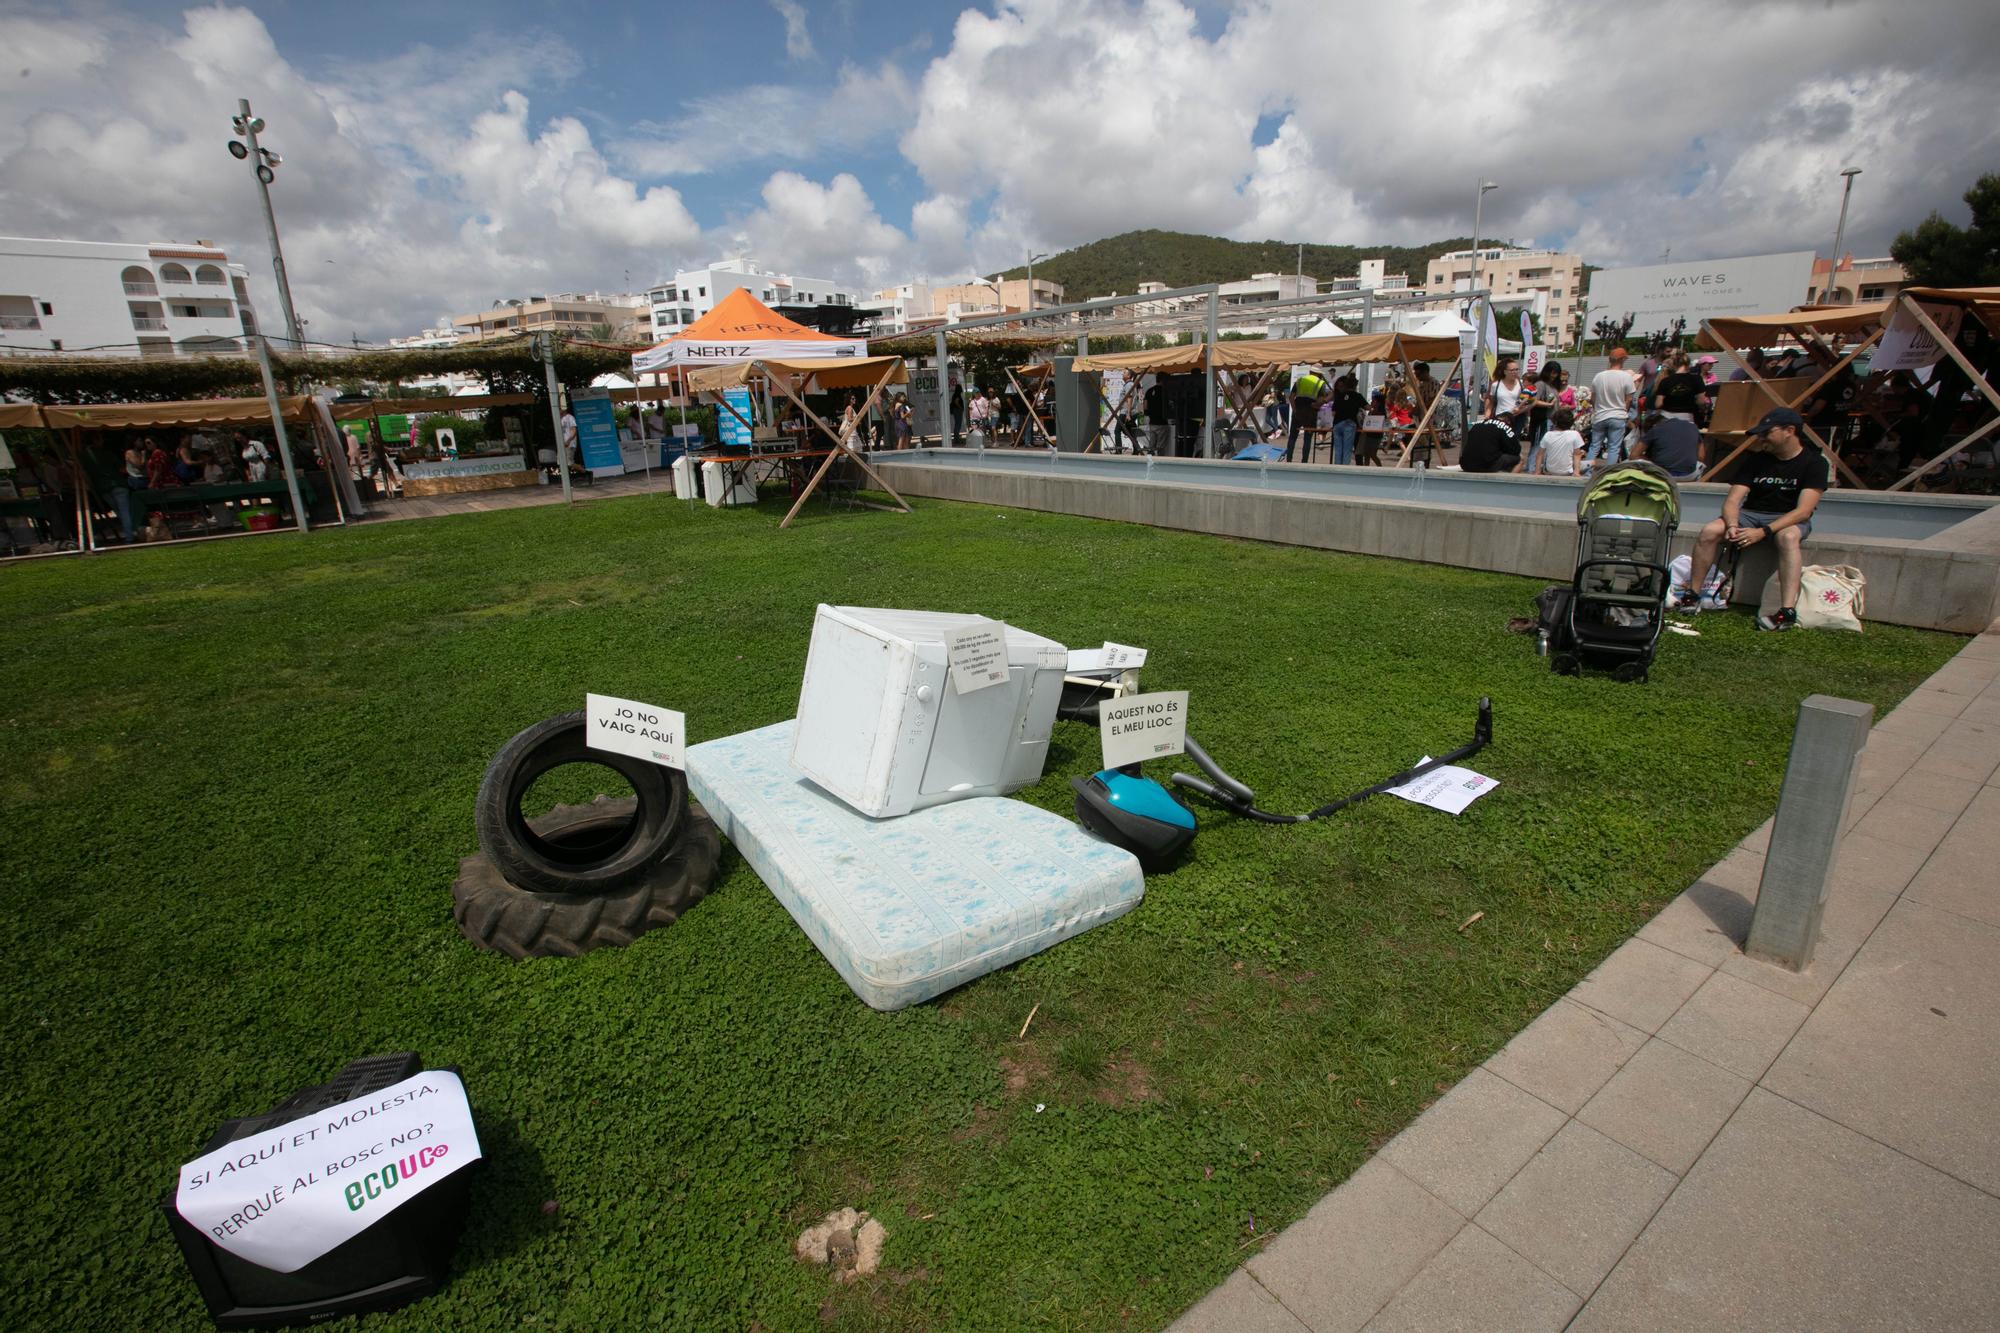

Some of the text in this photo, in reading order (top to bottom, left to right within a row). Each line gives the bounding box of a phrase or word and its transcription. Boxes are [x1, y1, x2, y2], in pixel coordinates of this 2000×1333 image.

[1663, 273, 1726, 288] WAVES
[1703, 287, 1743, 295] HOMES
[720, 323, 801, 334] HERTZ
[687, 346, 751, 357] HERTZ
[441, 463, 501, 476] alternativa
[615, 708, 658, 725] JO NO
[1107, 700, 1178, 722] AQUEST NO ÉS
[599, 718, 673, 744] VAIG AQUÍ
[1112, 717, 1173, 735] EL MEU LLOC
[189, 1085, 439, 1191] SI AQUÍ ET MOLESTA,
[212, 1122, 434, 1241] PERQUÈ AL BOSC NO?
